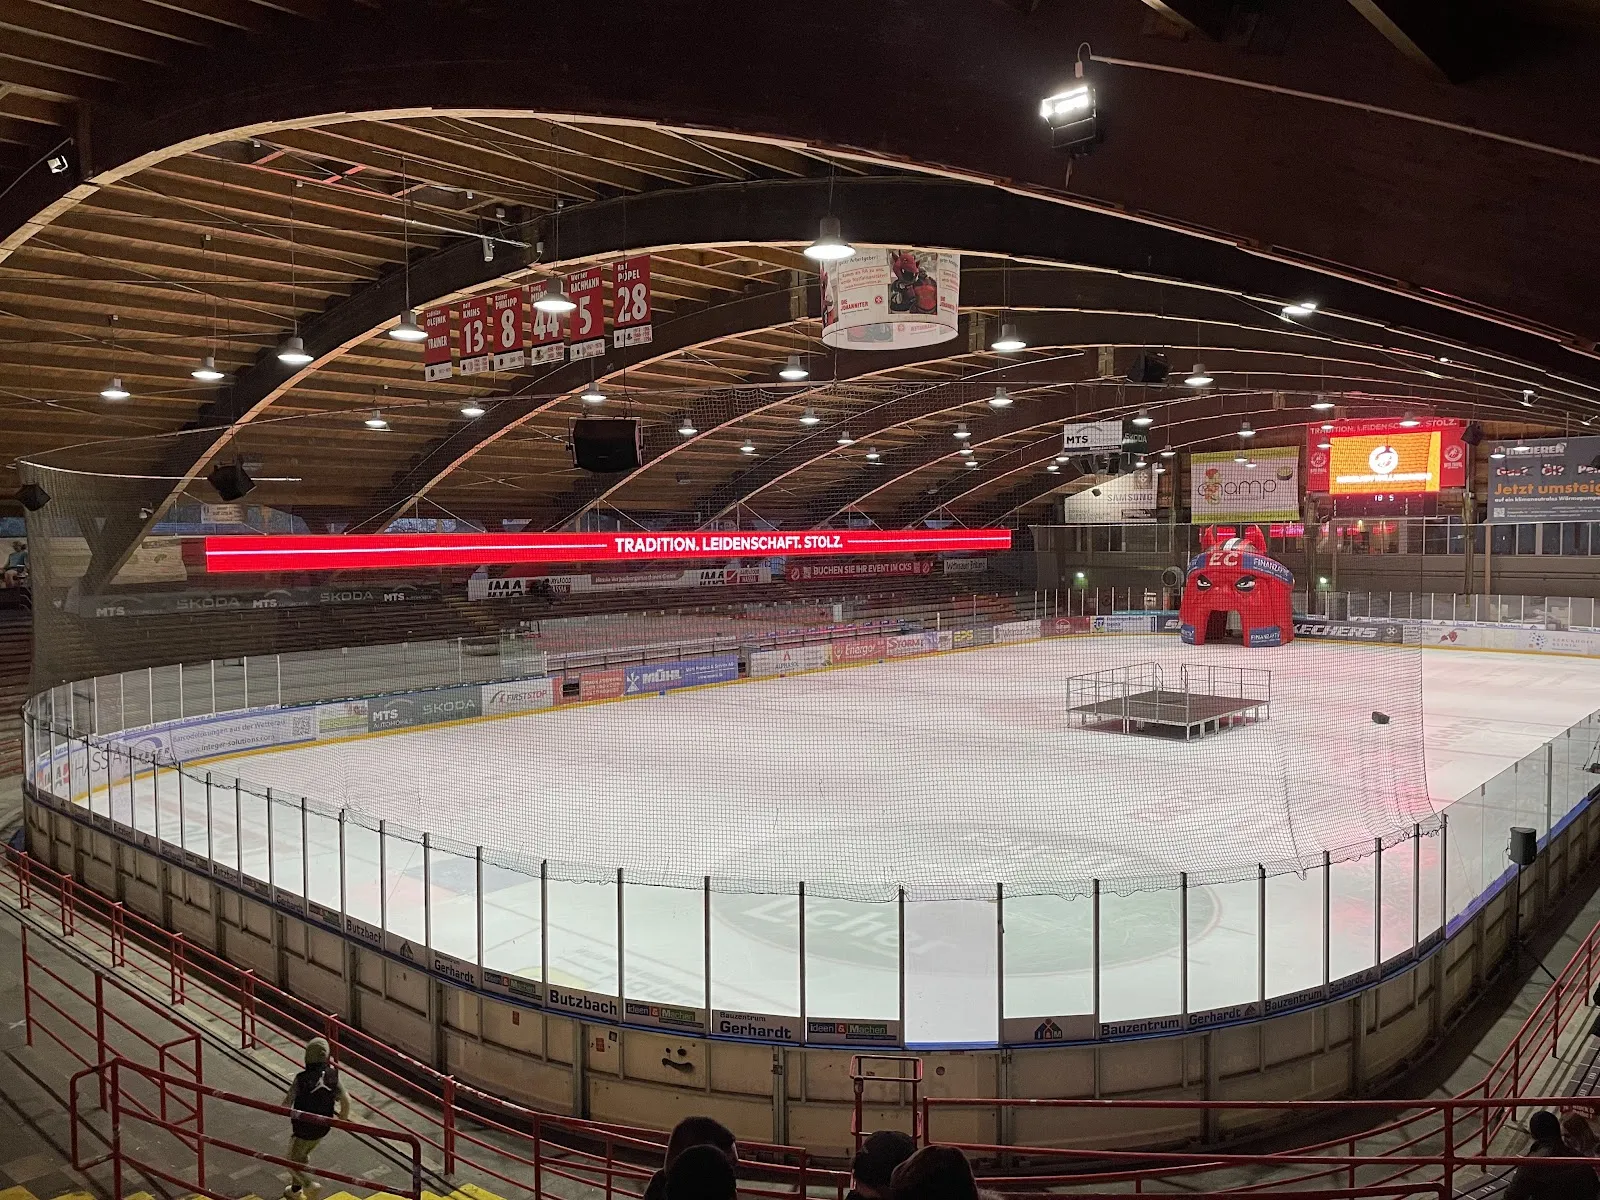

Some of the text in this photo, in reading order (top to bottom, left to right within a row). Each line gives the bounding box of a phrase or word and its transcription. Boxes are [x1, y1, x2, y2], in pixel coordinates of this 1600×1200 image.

[570, 277, 600, 294] BACHMANN
[495, 297, 518, 310] PHILIPP
[617, 283, 648, 323] 28
[841, 301, 869, 312] JOHANNITER
[579, 295, 592, 335] 5
[501, 308, 516, 348] 8
[533, 309, 560, 341] 44
[427, 335, 448, 349] TRAINER
[463, 319, 484, 354] 13
[1425, 419, 1457, 428] STOLZ.
[1066, 435, 1089, 444] MTS
[1494, 483, 1534, 495] Jetzt
[1107, 493, 1153, 502] SAMSUNG
[614, 535, 843, 553] TRADITION. LEIDENSCHAFT. STOLZ.
[1208, 552, 1239, 567] EC
[813, 564, 844, 576] BUCHEN
[844, 564, 856, 574] SIE
[855, 563, 868, 574] IHR
[868, 563, 889, 573] EVENT
[898, 562, 912, 572] CKS
[252, 599, 277, 608] MTS
[384, 592, 405, 601] MTS
[96, 607, 125, 617] MTS
[953, 629, 974, 642] EPS
[642, 668, 682, 684] MÜHL
[372, 709, 399, 722] MTS
[434, 959, 475, 984] Gerhardt
[1329, 973, 1364, 995] Gerhardt
[550, 989, 617, 1015] Butzbach
[1264, 988, 1322, 1012] Bauzentrum
[719, 1011, 766, 1022] Bauzentrum
[1188, 1007, 1241, 1026] Gerhardt
[719, 1021, 792, 1040] Gerhardt
[837, 1024, 846, 1033] &
[849, 1025, 886, 1034] Machen
[1101, 1018, 1180, 1037] Bauzentrum
